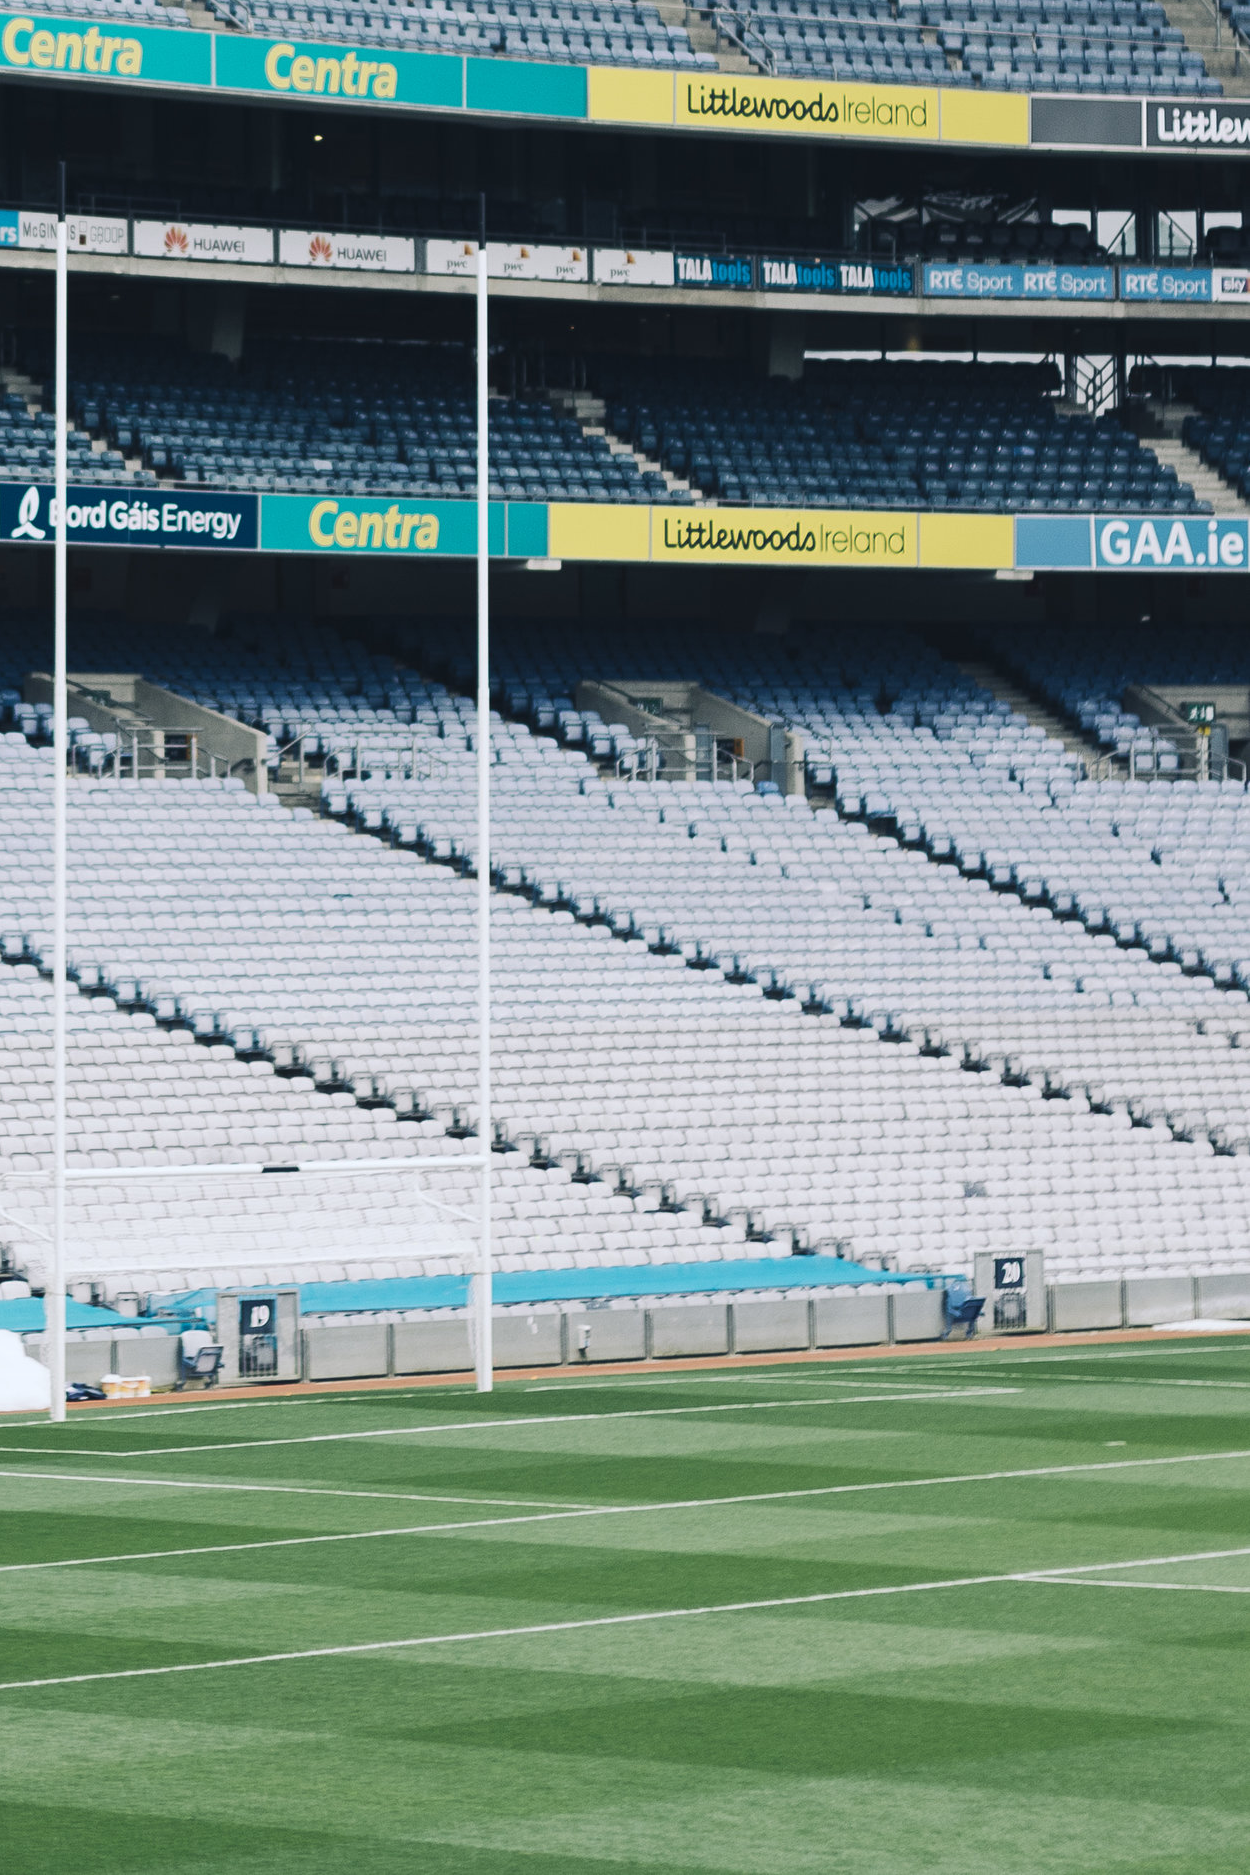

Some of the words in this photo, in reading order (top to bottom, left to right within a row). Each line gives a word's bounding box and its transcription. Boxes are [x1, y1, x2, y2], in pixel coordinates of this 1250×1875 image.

[2, 17, 144, 76] Centra
[265, 43, 399, 99] Centra
[687, 83, 840, 123] Littlewoods
[843, 94, 928, 128] Ireland
[22, 221, 76, 241] McGINIS
[193, 238, 246, 254] HUAWEI
[337, 246, 387, 262] HUAWEI
[446, 259, 468, 271] pwc
[503, 262, 524, 273] pwc
[555, 265, 576, 276] pwc
[610, 267, 630, 278] pwc
[967, 272, 1013, 293] Sport
[1061, 274, 1106, 295] Sport
[1162, 274, 1207, 297] Sport
[1223, 277, 1246, 293] sky
[109, 500, 160, 531] Gáis
[162, 504, 241, 539] Energy
[308, 499, 440, 550] Centra
[663, 518, 816, 552] Littlewoods
[820, 524, 905, 554] Ireland
[1100, 519, 1244, 565] GAA.ie
[1001, 1261, 1021, 1284] 20
[250, 1304, 270, 1328] 19
